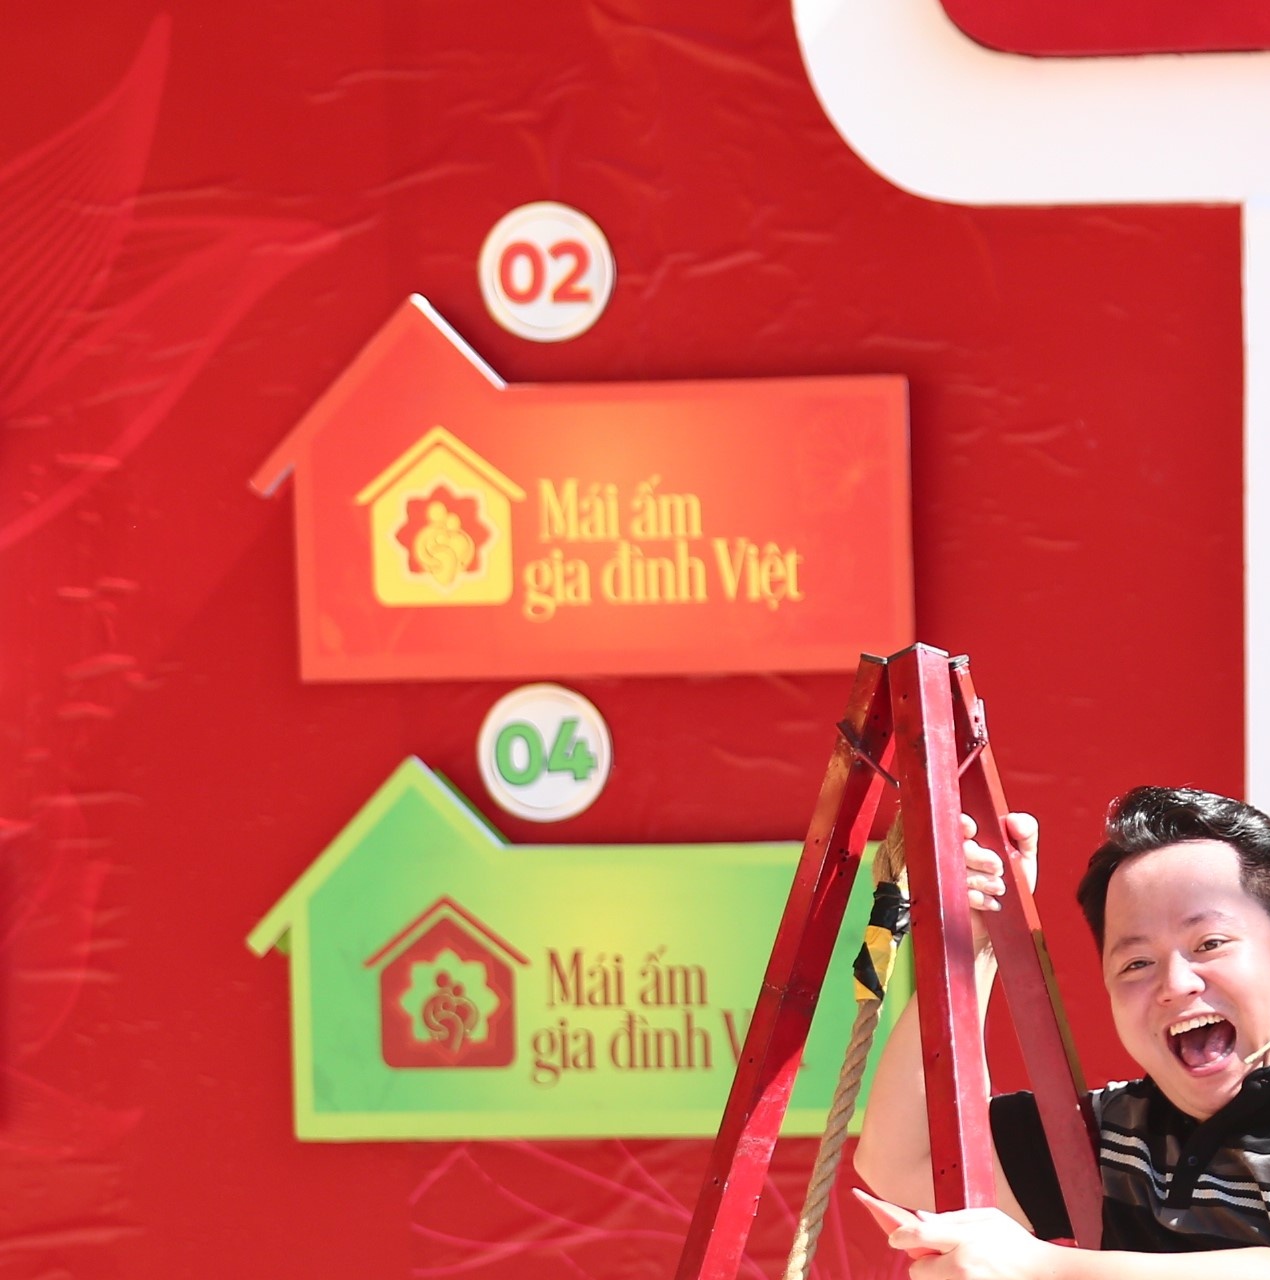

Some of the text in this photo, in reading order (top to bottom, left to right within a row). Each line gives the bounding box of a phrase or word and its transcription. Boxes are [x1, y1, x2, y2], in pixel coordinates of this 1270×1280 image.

[499, 240, 592, 303] 02
[539, 474, 702, 541] Mái ấm
[522, 537, 803, 621] gia đình Việt
[495, 718, 596, 786] 04
[546, 946, 709, 1007] Mái ấm
[531, 1016, 596, 1086] gia
[609, 1011, 712, 1071] đình
